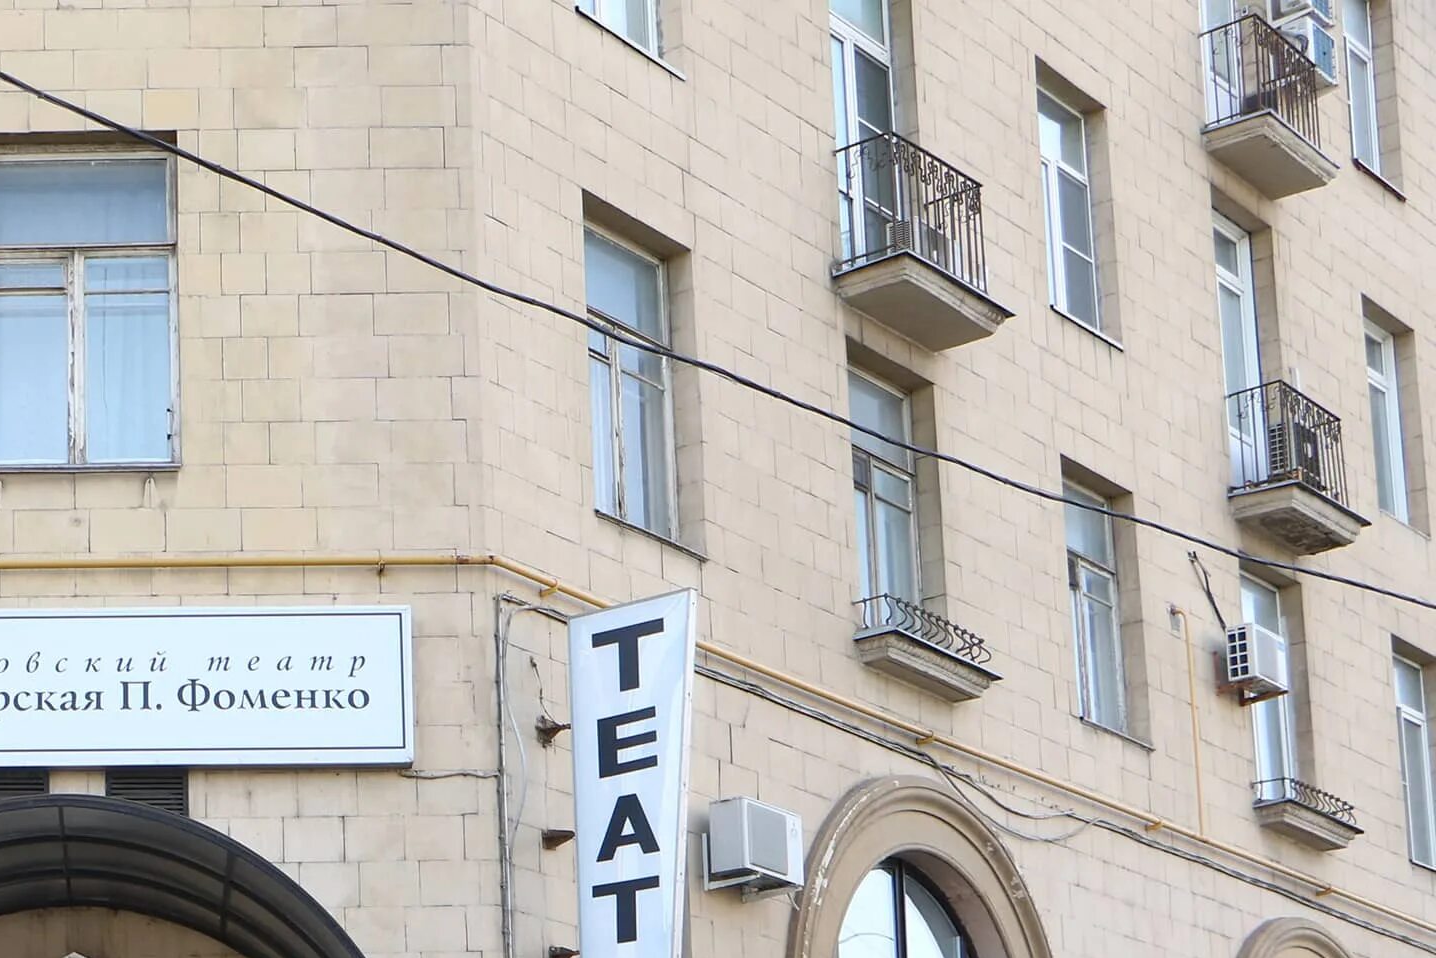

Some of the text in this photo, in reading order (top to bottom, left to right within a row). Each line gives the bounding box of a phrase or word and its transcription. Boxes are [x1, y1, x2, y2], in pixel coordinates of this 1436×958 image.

[207, 654, 366, 678] театр
[119, 680, 163, 711] П.
[176, 678, 371, 712] Фоменко
